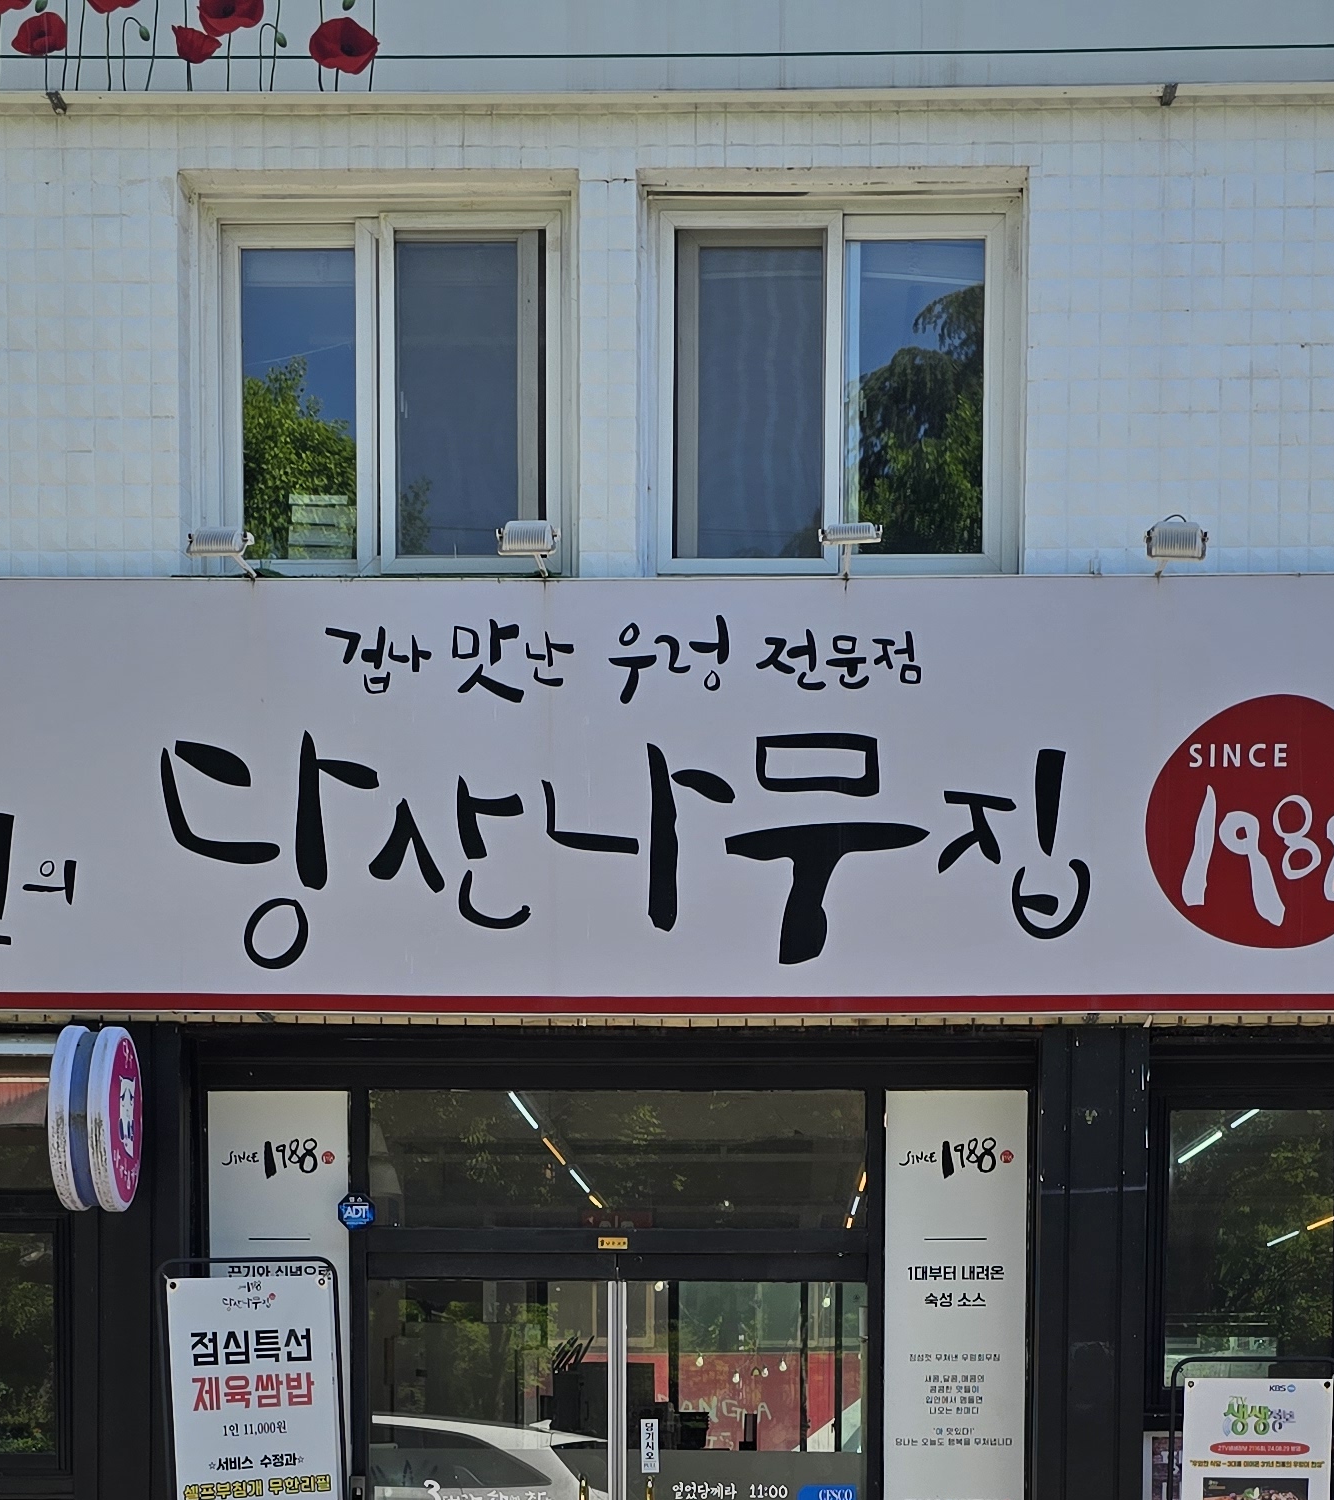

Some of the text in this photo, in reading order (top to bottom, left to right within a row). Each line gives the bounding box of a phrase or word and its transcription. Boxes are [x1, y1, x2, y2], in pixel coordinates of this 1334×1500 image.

[325, 614, 924, 704] 겁나 맛난 우렁 전문점
[1188, 743, 1288, 768] SINCE
[160, 729, 1091, 970] 당산나무집
[222, 1138, 318, 1179] SINCE 1988
[899, 1137, 997, 1179] SINCE 1988
[343, 1205, 369, 1219] ADT
[907, 1265, 1005, 1281] 1대부터 내려온
[924, 1292, 986, 1307] 숙성 소스
[190, 1328, 313, 1366] 점심특선
[191, 1372, 315, 1411] 제육쌈밥
[1269, 1384, 1287, 1392] KBS
[930, 1406, 953, 1415] 나오는
[223, 1420, 287, 1436] 1인 11,000원
[644, 1422, 655, 1460] 당기시오
[216, 1453, 298, 1470] 서비스 수정과
[268, 1474, 332, 1495] 무한리필
[672, 1482, 788, 1500] 열었당께라 11:00
[818, 1488, 853, 1500] CESCO
